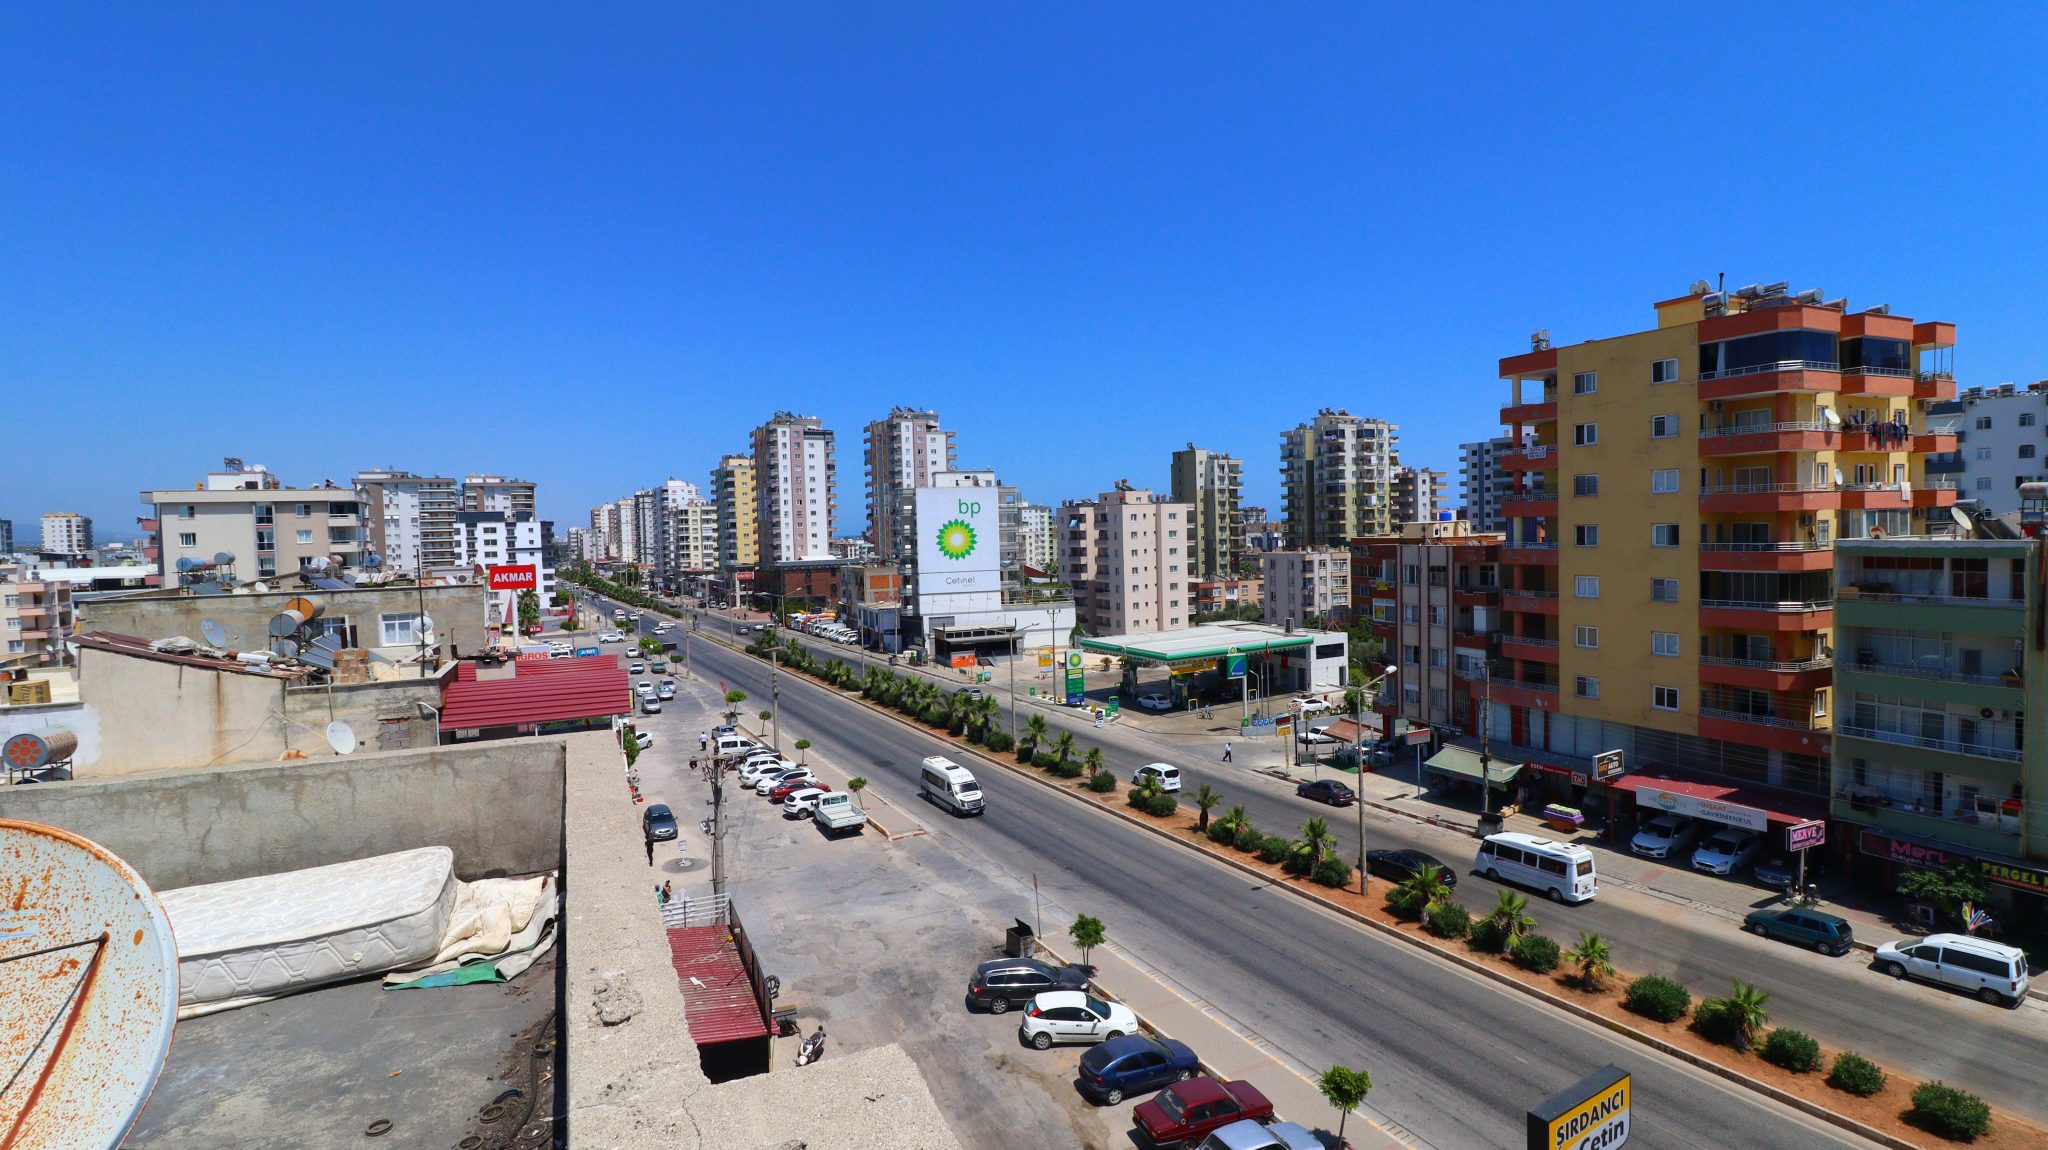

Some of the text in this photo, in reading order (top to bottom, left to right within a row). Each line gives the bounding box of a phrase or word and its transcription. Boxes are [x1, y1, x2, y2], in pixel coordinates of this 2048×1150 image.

[958, 498, 981, 518] bp
[494, 572, 533, 583] AKMAR
[516, 651, 549, 661] IGROS
[1982, 862, 2039, 885] PERGEL
